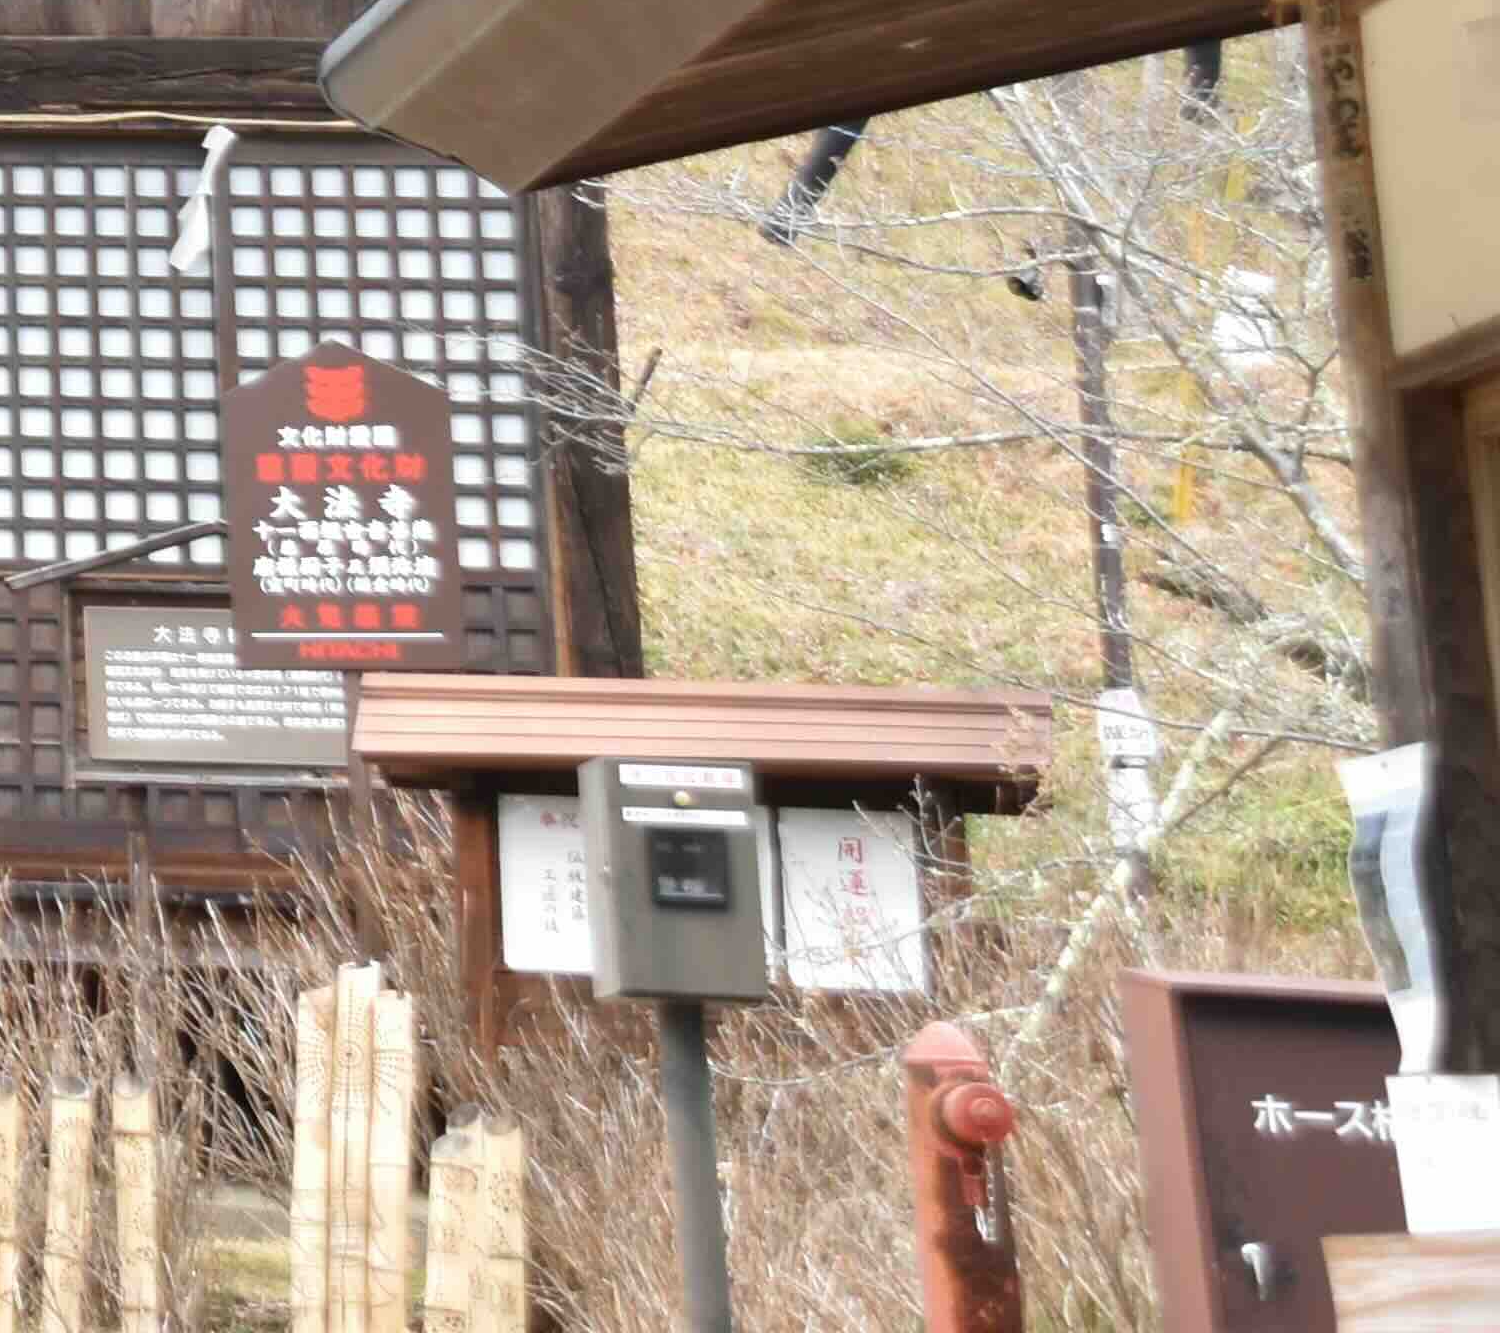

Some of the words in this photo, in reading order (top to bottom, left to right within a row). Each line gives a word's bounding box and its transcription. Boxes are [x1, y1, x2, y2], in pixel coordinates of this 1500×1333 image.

[269, 484, 419, 519] 大法寺
[153, 626, 235, 644] 大法寺
